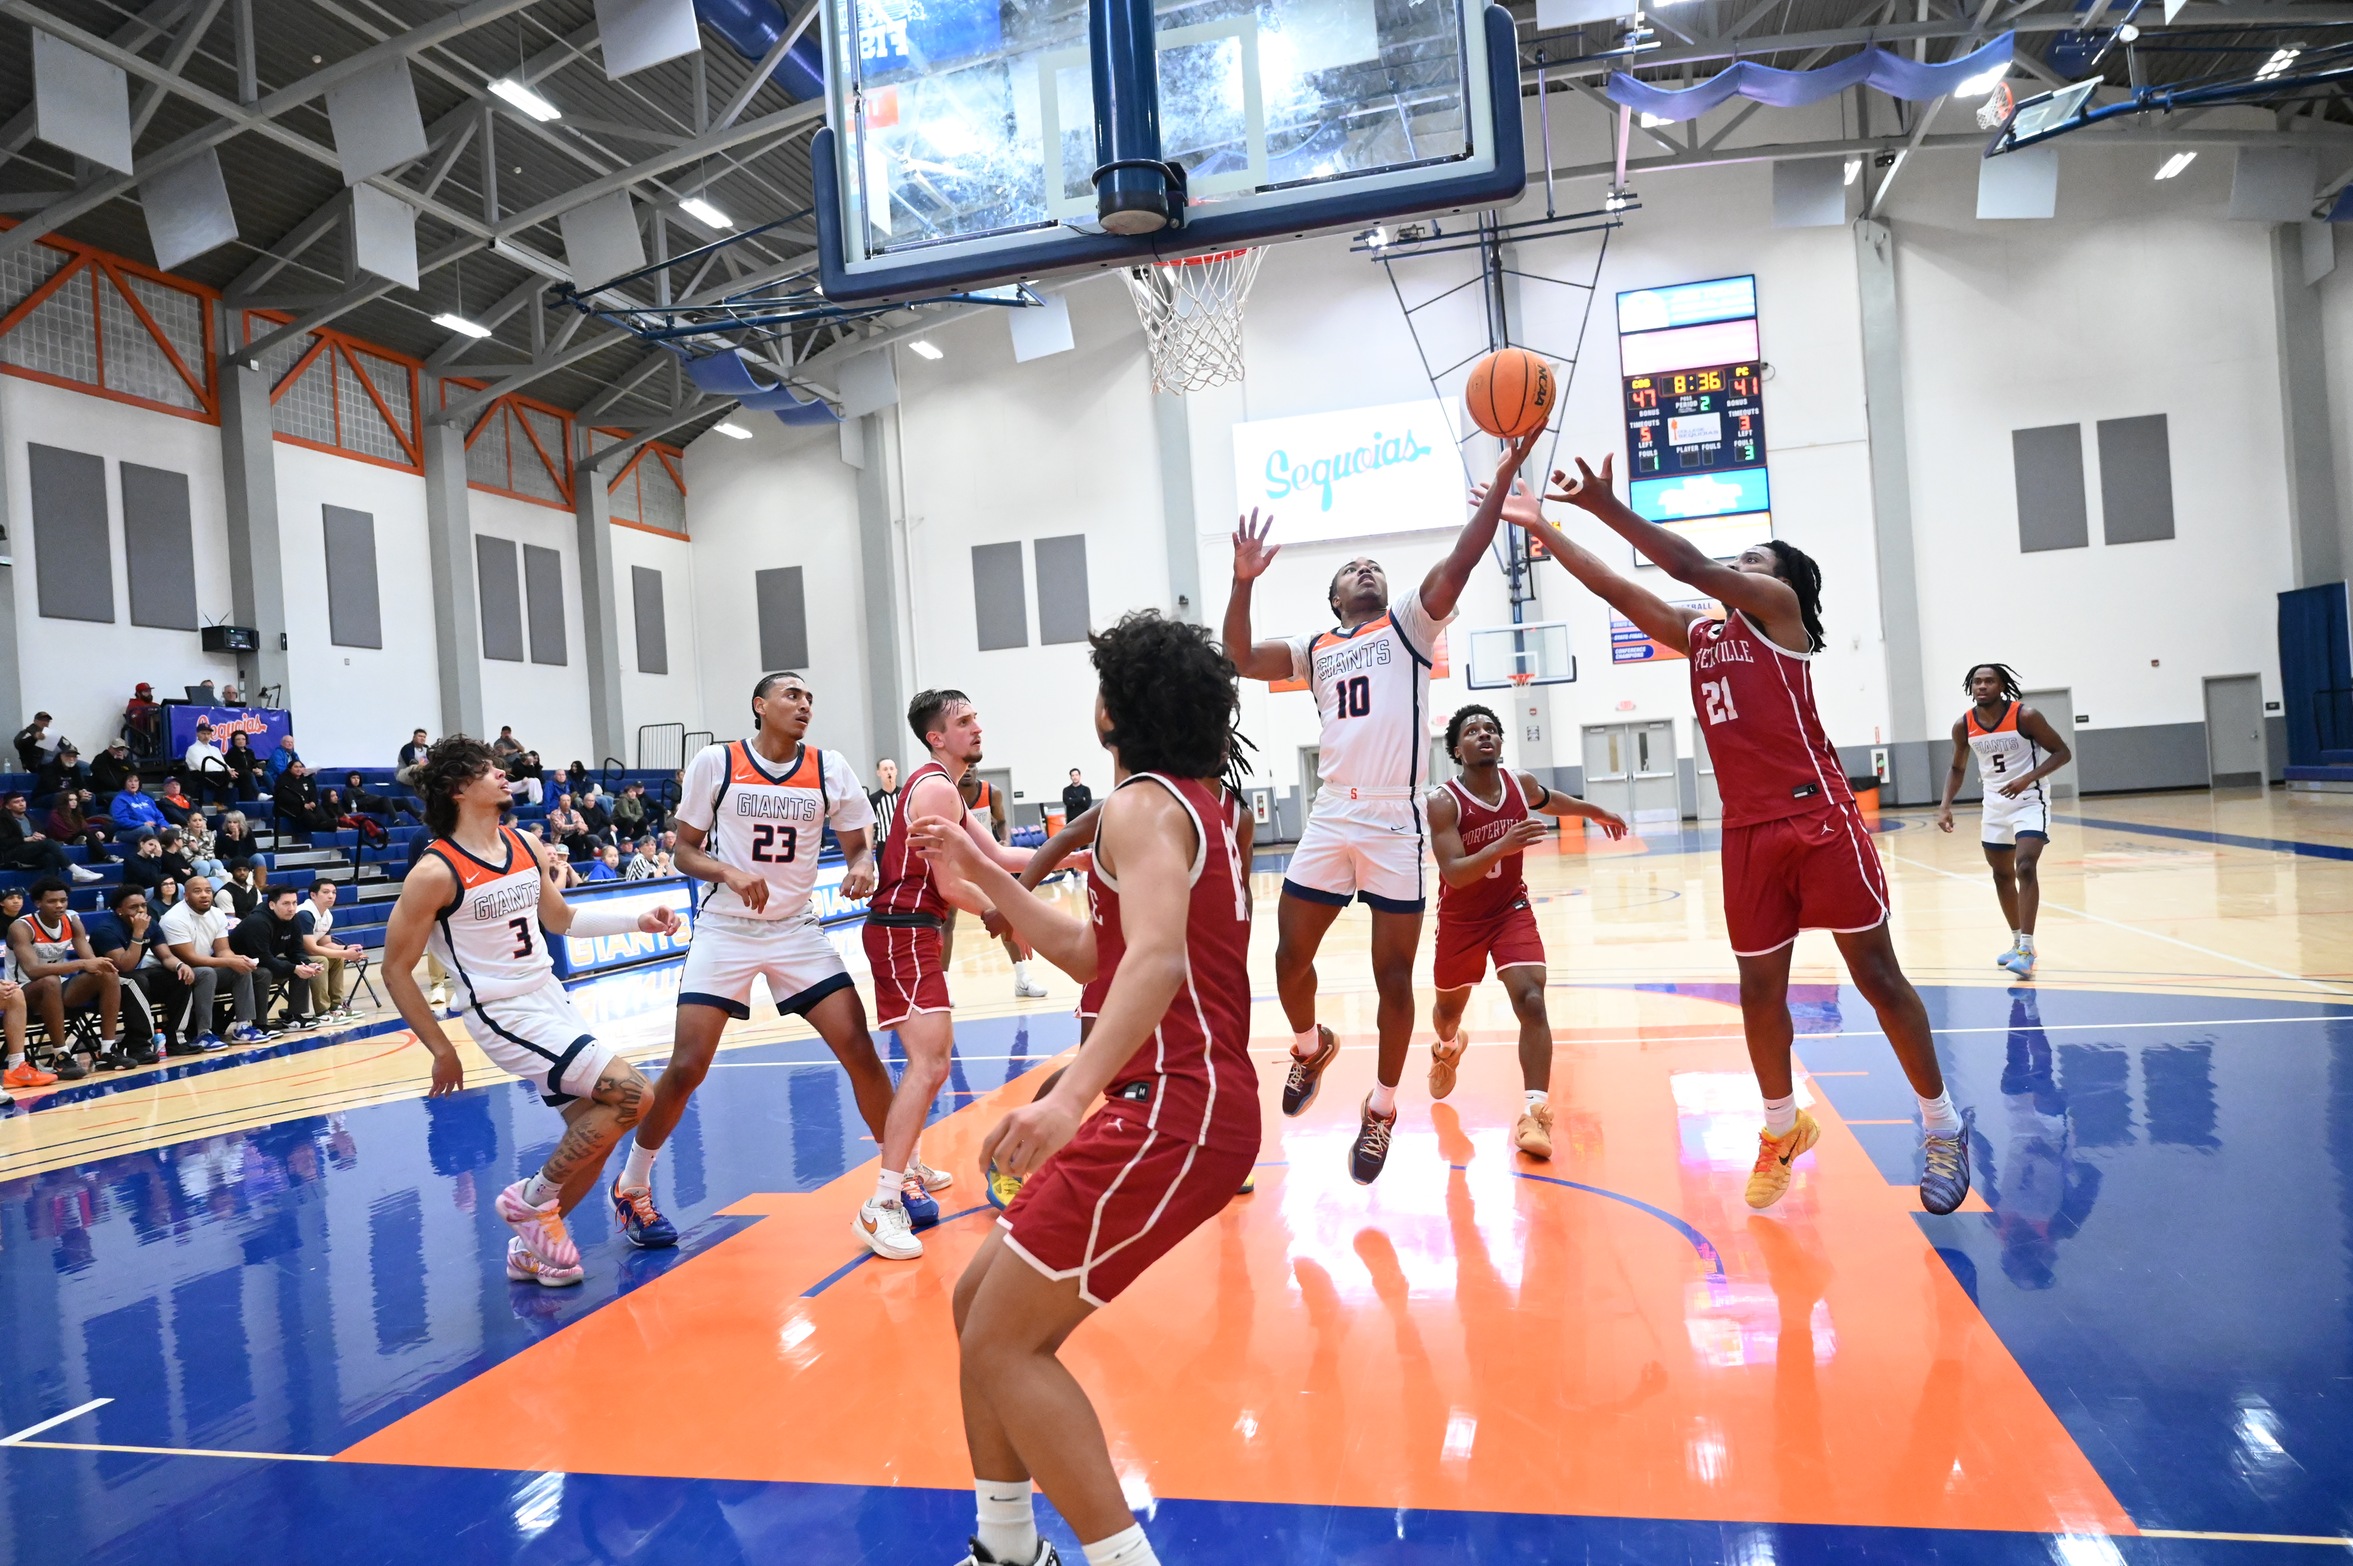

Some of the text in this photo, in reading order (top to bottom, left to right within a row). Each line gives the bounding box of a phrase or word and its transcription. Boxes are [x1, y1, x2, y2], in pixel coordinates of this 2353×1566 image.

[1534, 364, 1548, 406] NCAA
[1673, 371, 1722, 394] 8:36
[1734, 376, 1759, 396] 41
[1632, 389, 1657, 408] 47
[1675, 400, 1698, 409] PERIOD
[1699, 395, 1711, 411] 2
[1726, 398, 1748, 407] BONUS
[1638, 408, 1660, 417] BONUS
[1728, 408, 1760, 417] TIMEOUTS
[1629, 419, 1660, 429] TIMEOUTS
[1739, 415, 1751, 430] 3
[1639, 426, 1652, 442] 5
[1737, 429, 1753, 438] LEFT
[1638, 440, 1653, 449] LEFT
[1676, 442, 1721, 454] PLAYER FOULS
[1734, 438, 1754, 447] FOULS
[1638, 449, 1658, 457] FOULS
[1744, 445, 1755, 461] 3
[1265, 429, 1432, 512] Sequoias
[1653, 455, 1660, 471] 1
[1316, 639, 1391, 681] GIANTS
[1336, 675, 1370, 720] 10
[1701, 676, 1739, 725] 21
[1992, 753, 2006, 773] 5
[1350, 787, 1358, 800] S
[737, 792, 816, 821] GIANTS
[752, 823, 797, 863] 23
[474, 880, 540, 920] GIANTS
[509, 916, 533, 959] 3
[1138, 1087, 1147, 1098] M
